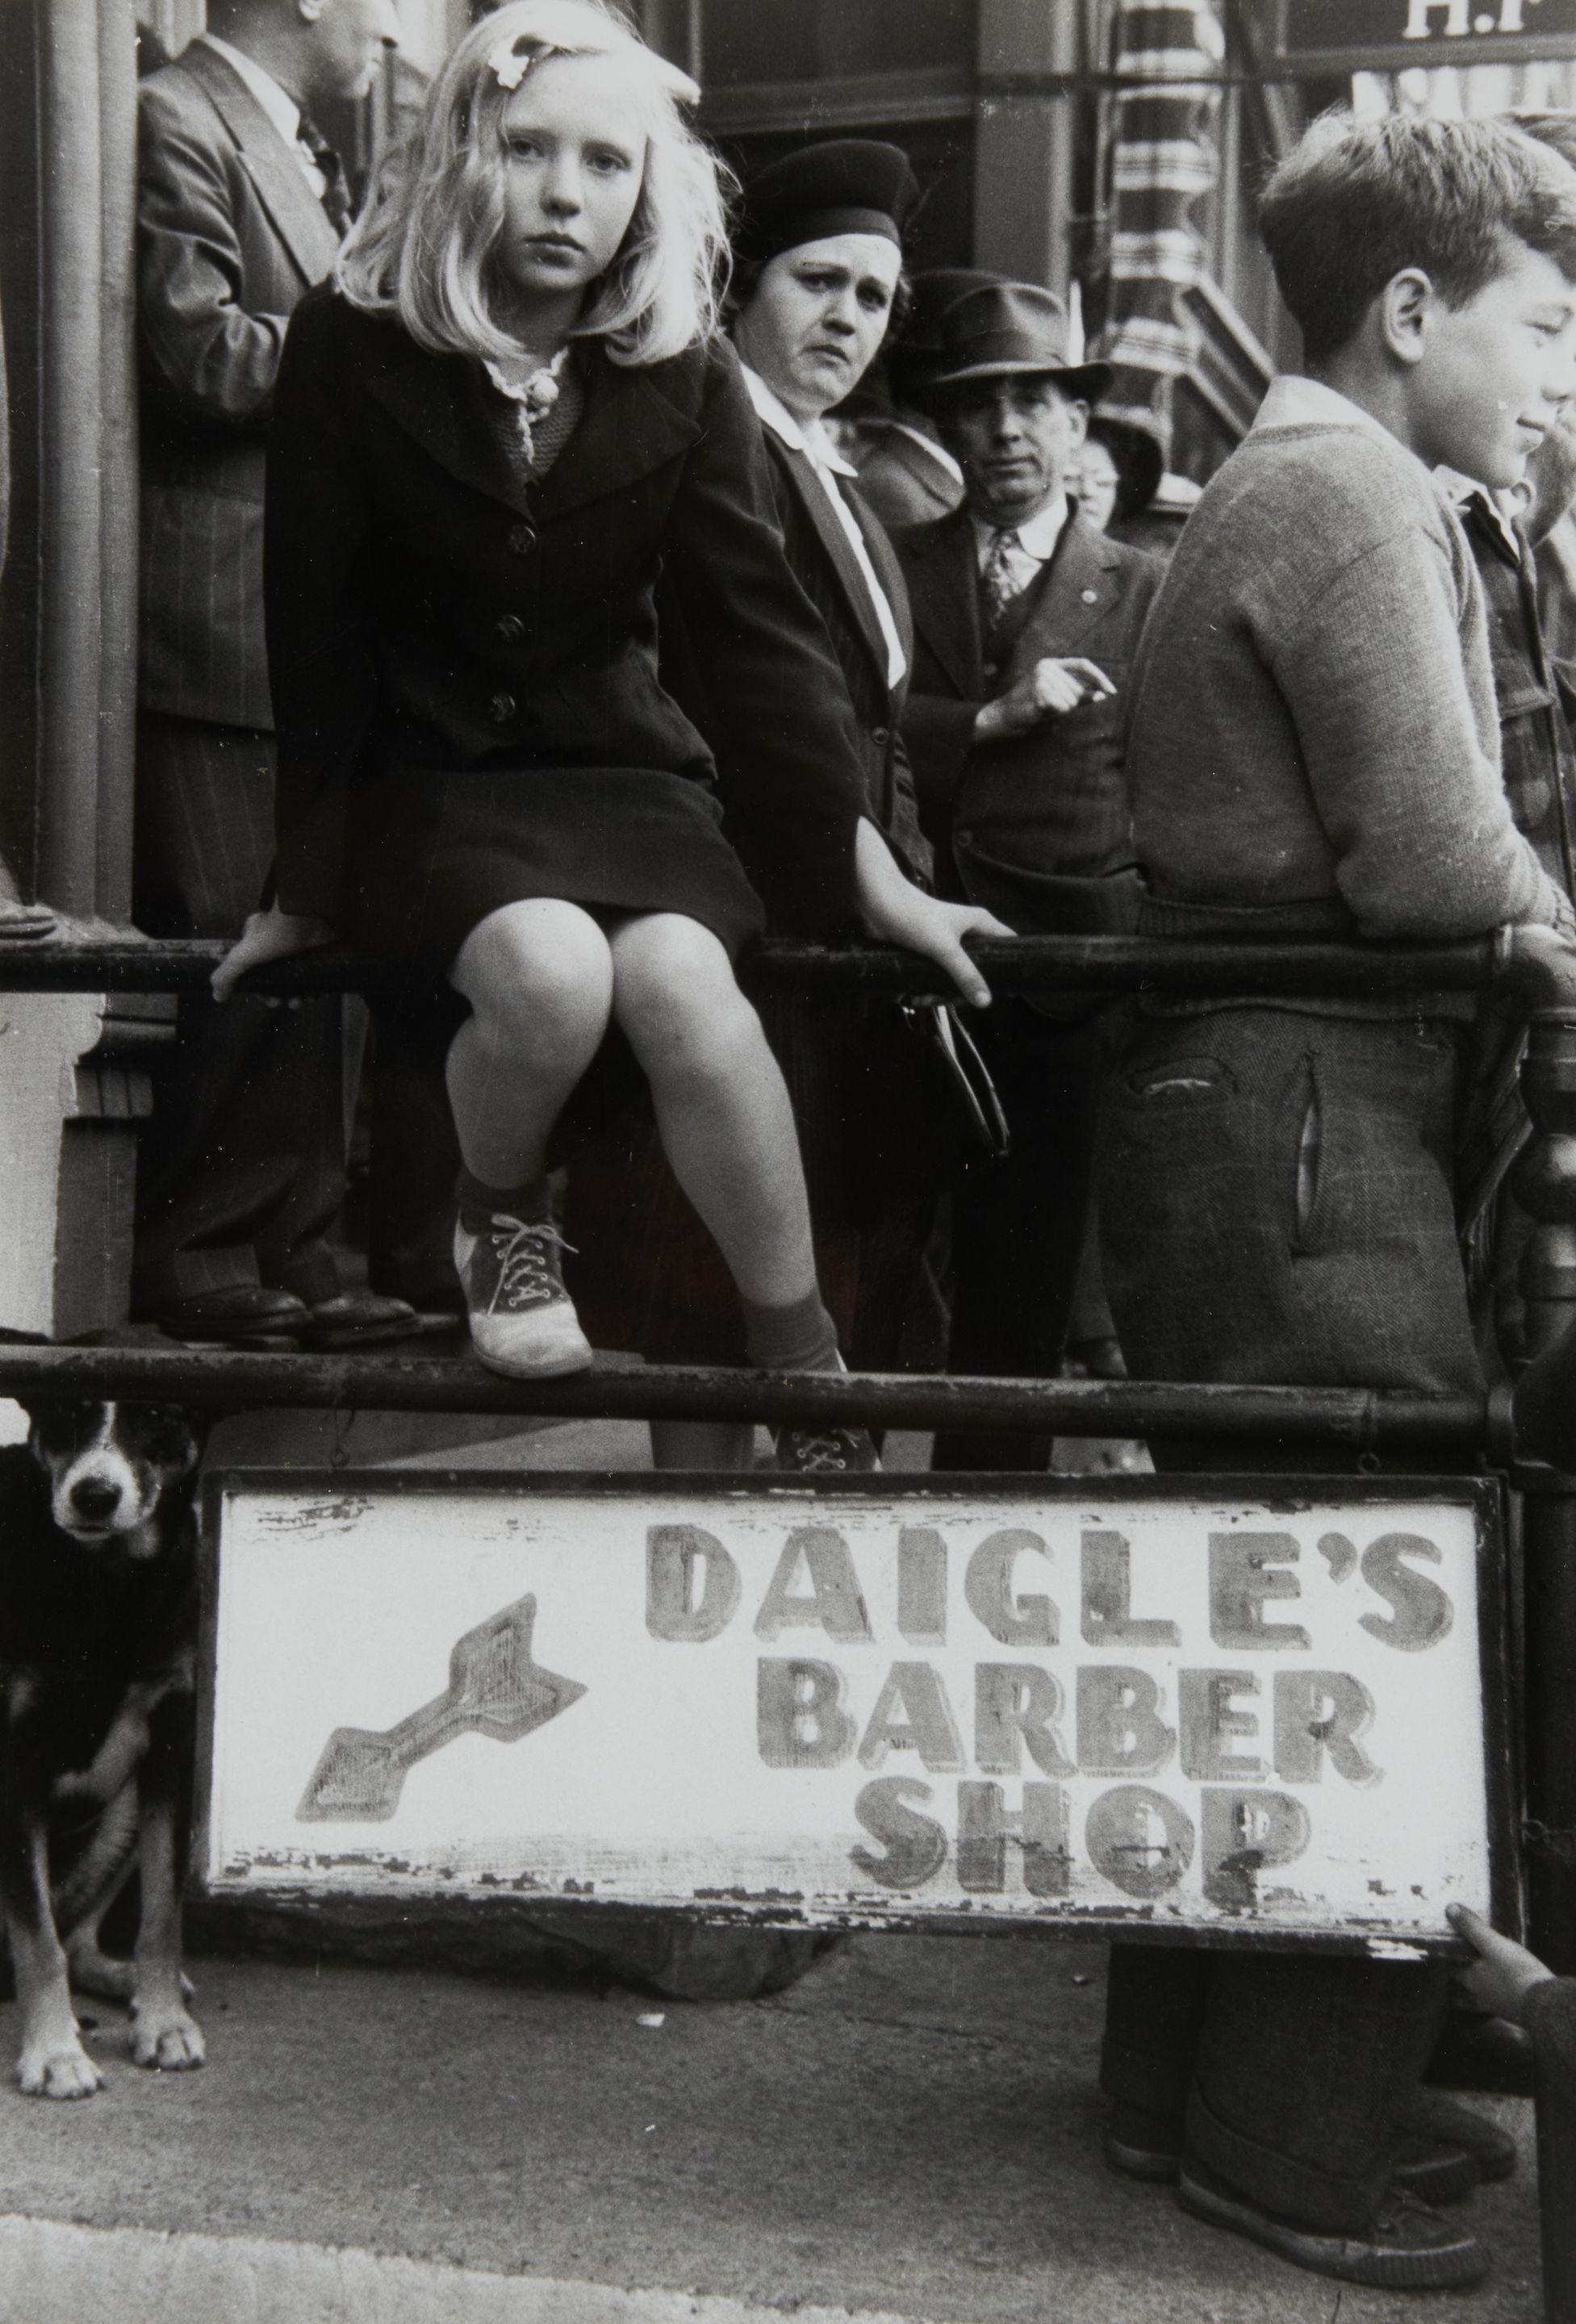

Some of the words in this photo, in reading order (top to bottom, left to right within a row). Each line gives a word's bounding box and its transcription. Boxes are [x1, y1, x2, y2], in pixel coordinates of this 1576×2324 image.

[646, 1524, 1454, 1651] DAIGLE'S
[757, 1657, 1383, 1786] BARBER
[850, 1777, 1312, 1908] SHOP
